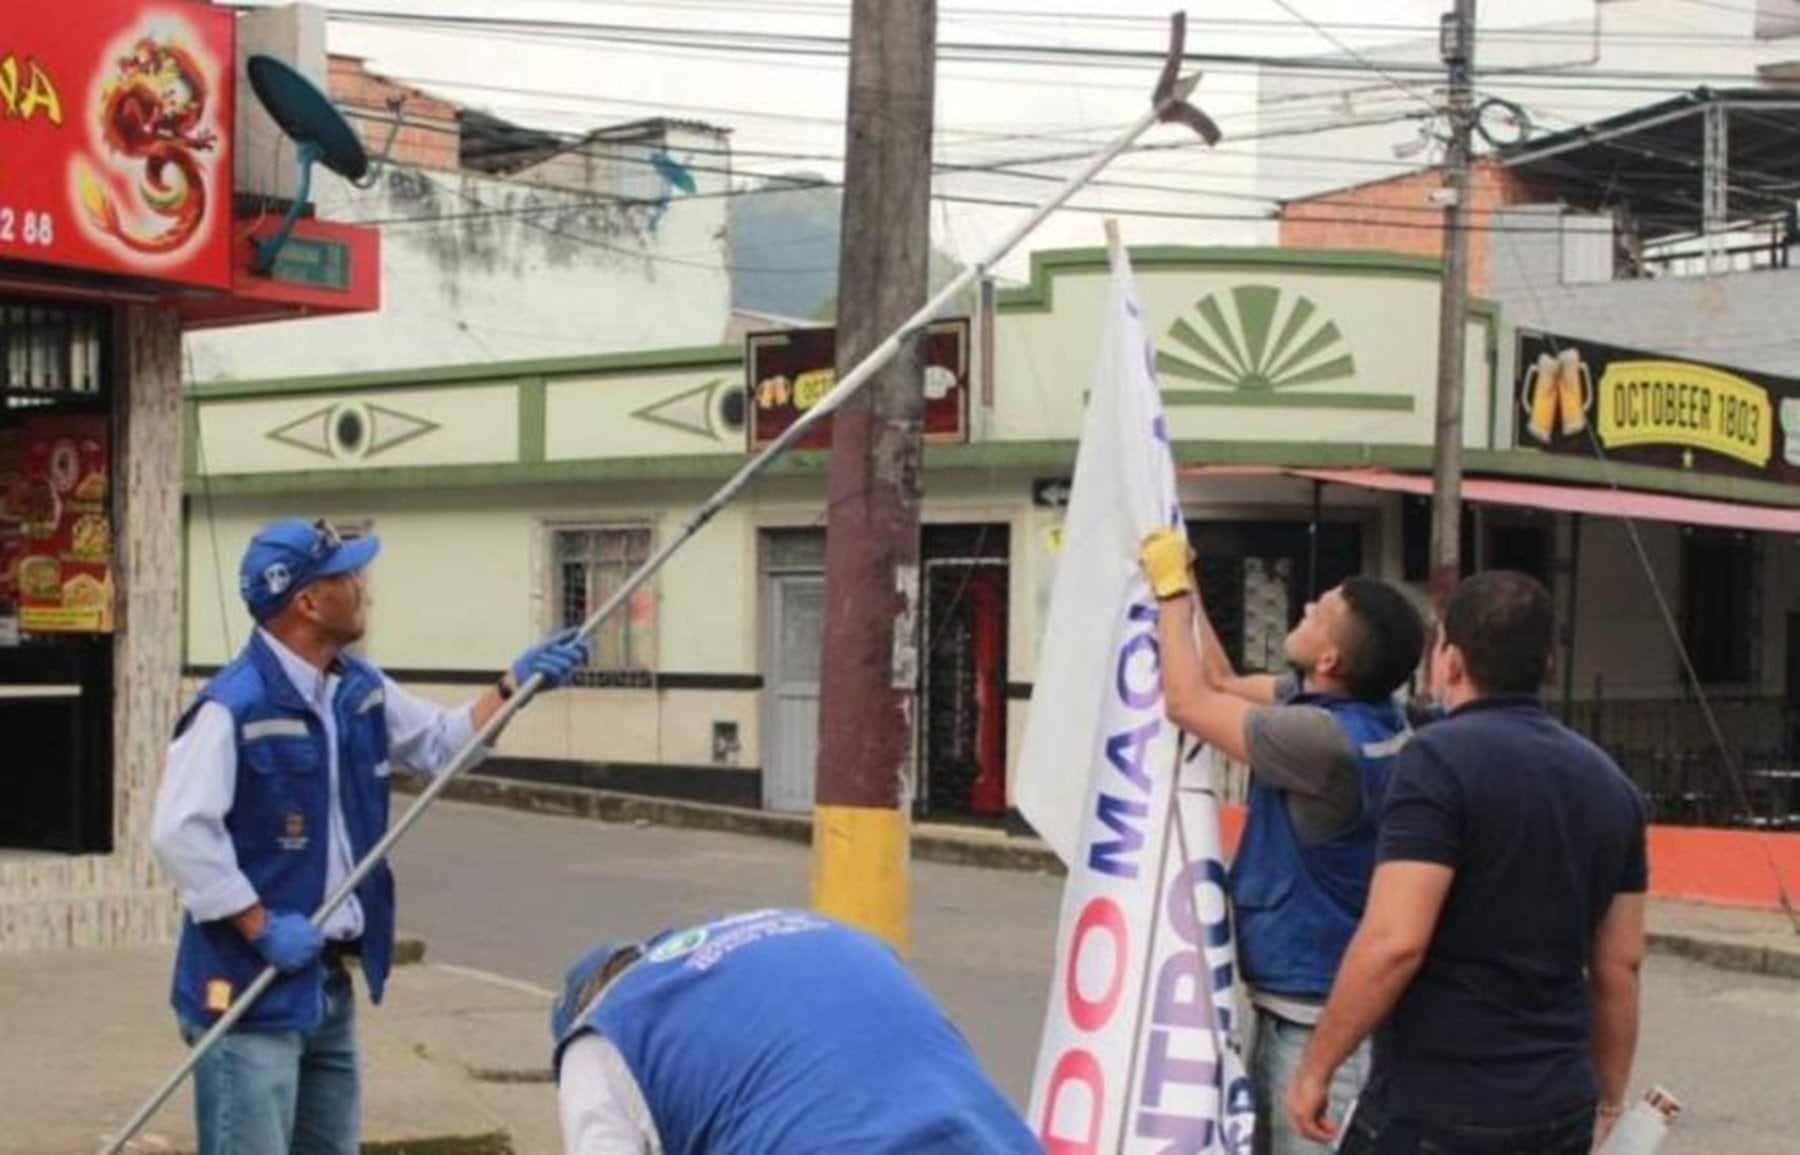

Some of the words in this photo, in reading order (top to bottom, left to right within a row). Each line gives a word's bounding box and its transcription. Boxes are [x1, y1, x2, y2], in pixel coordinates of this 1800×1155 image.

[23, 208, 53, 246] 88
[1613, 380, 1712, 431] OCTOBEER
[1717, 393, 1761, 447] 1803
